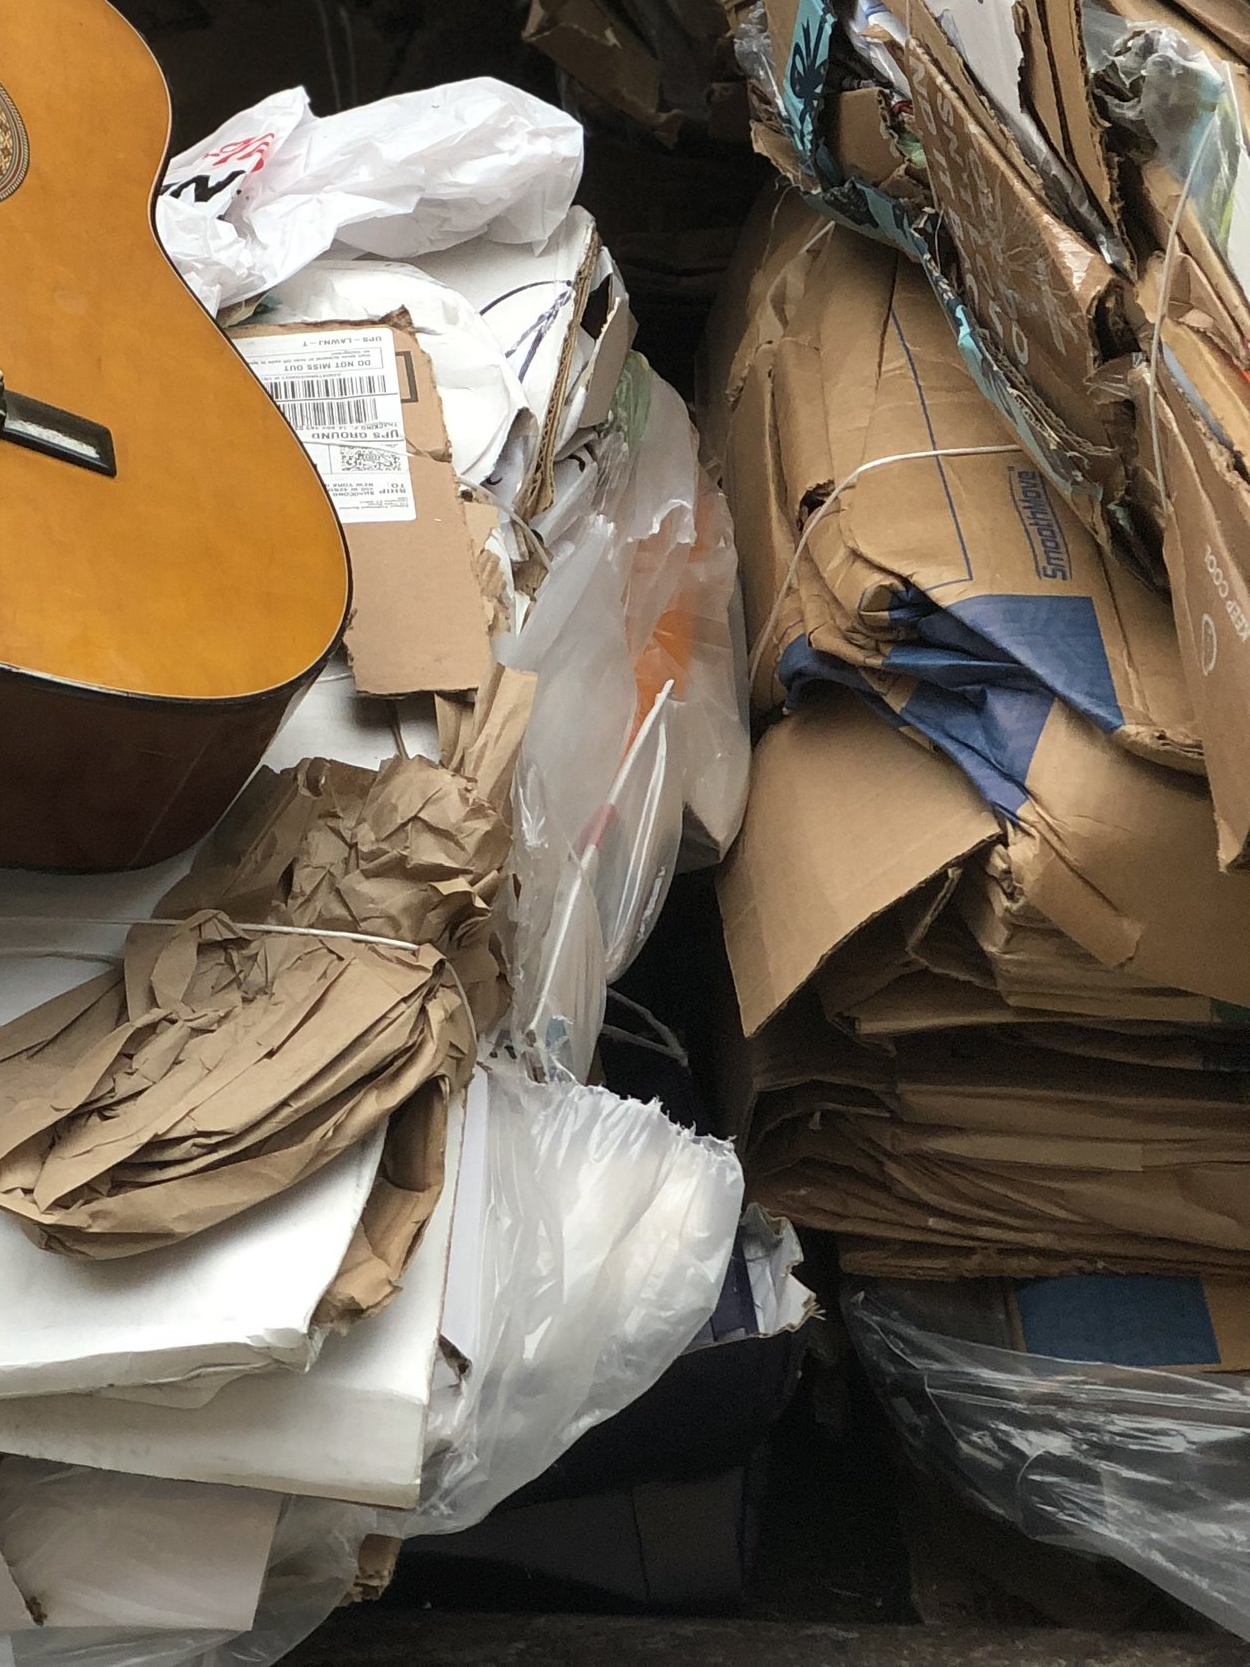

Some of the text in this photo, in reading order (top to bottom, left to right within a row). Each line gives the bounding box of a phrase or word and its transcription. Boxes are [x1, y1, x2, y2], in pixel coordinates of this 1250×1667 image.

[284, 359, 371, 372] DO NOT MISS OUT
[311, 429, 400, 440] UPS GROUND
[1017, 470, 1068, 581] SmoothMove
[1205, 543, 1229, 598] COOL
